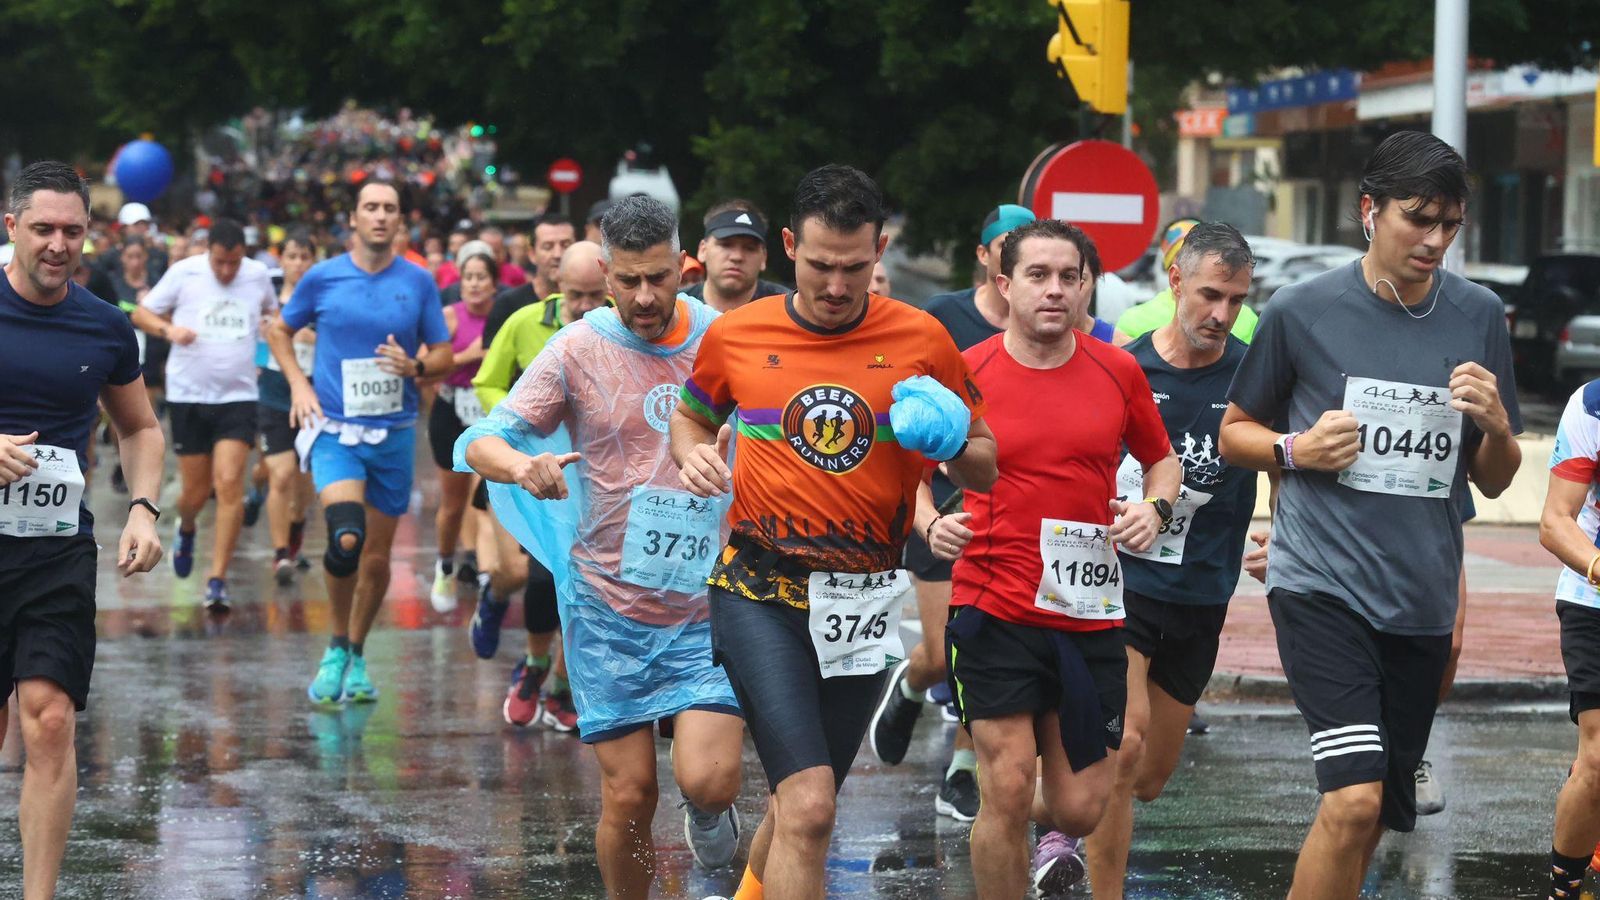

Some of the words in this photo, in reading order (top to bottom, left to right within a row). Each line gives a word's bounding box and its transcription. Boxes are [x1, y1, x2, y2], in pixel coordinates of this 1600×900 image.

[351, 378, 399, 397] 10033
[800, 389, 855, 407] BEER
[790, 436, 870, 469] RUNNERS
[1357, 424, 1452, 461] 10449
[642, 529, 711, 561] 3736
[1051, 559, 1120, 587] 11894
[824, 611, 889, 643] 3745
